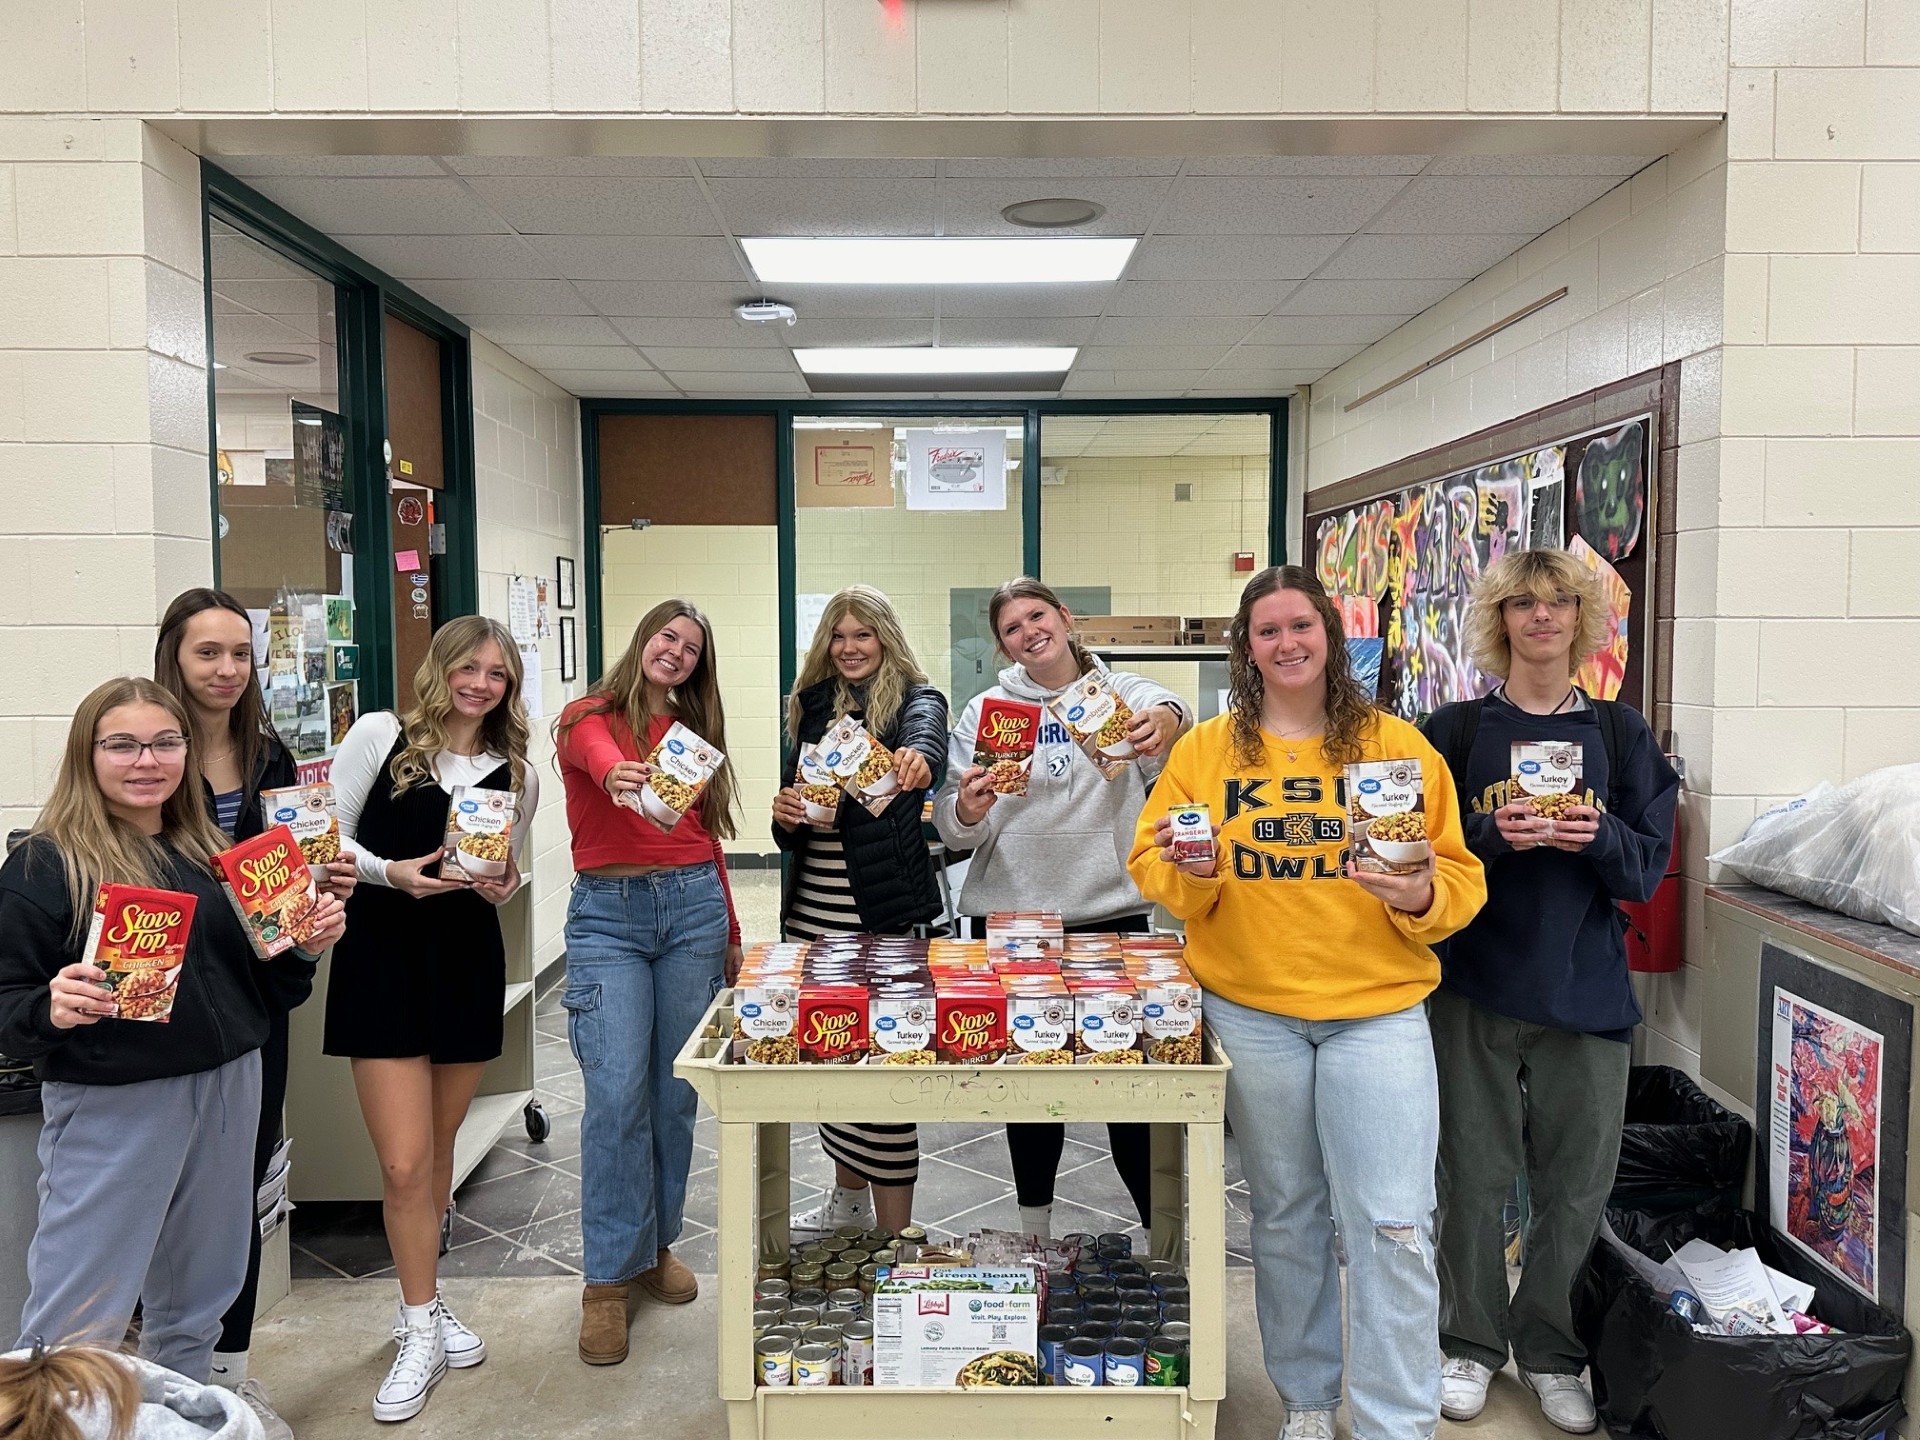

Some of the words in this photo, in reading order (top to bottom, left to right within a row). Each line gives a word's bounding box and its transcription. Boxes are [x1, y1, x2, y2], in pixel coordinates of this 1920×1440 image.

[982, 711, 1030, 739] Stove
[996, 730, 1022, 747] Top
[841, 742, 865, 766] Chicken
[994, 751, 1018, 759] TURKEY
[670, 755, 698, 778] Chicken
[1540, 774, 1568, 784] Turkey
[1381, 792, 1409, 802] Turkey
[289, 818, 326, 830] Chicken
[468, 814, 501, 826] Chicken
[1257, 821, 1274, 839] 19
[1320, 820, 1341, 838] 63
[239, 843, 289, 897] Stove
[263, 865, 290, 897] Top
[107, 904, 182, 943] Stove
[129, 930, 168, 954] Top
[122, 957, 164, 970] CHICKEN
[752, 1018, 787, 1027] Chicken
[803, 1010, 859, 1044] Stove
[941, 1010, 997, 1044] Stove
[1155, 1018, 1190, 1027] Chicken
[823, 1030, 851, 1052] Top
[897, 1031, 924, 1040] Turkey
[961, 1030, 989, 1052] Top
[1034, 1030, 1061, 1040] Turkey
[1103, 1030, 1129, 1040] Turkey
[823, 1053, 851, 1065] TURKEY
[961, 1053, 989, 1065] TURKEY
[932, 1271, 978, 1279] Green
[923, 1299, 945, 1309] Libby's
